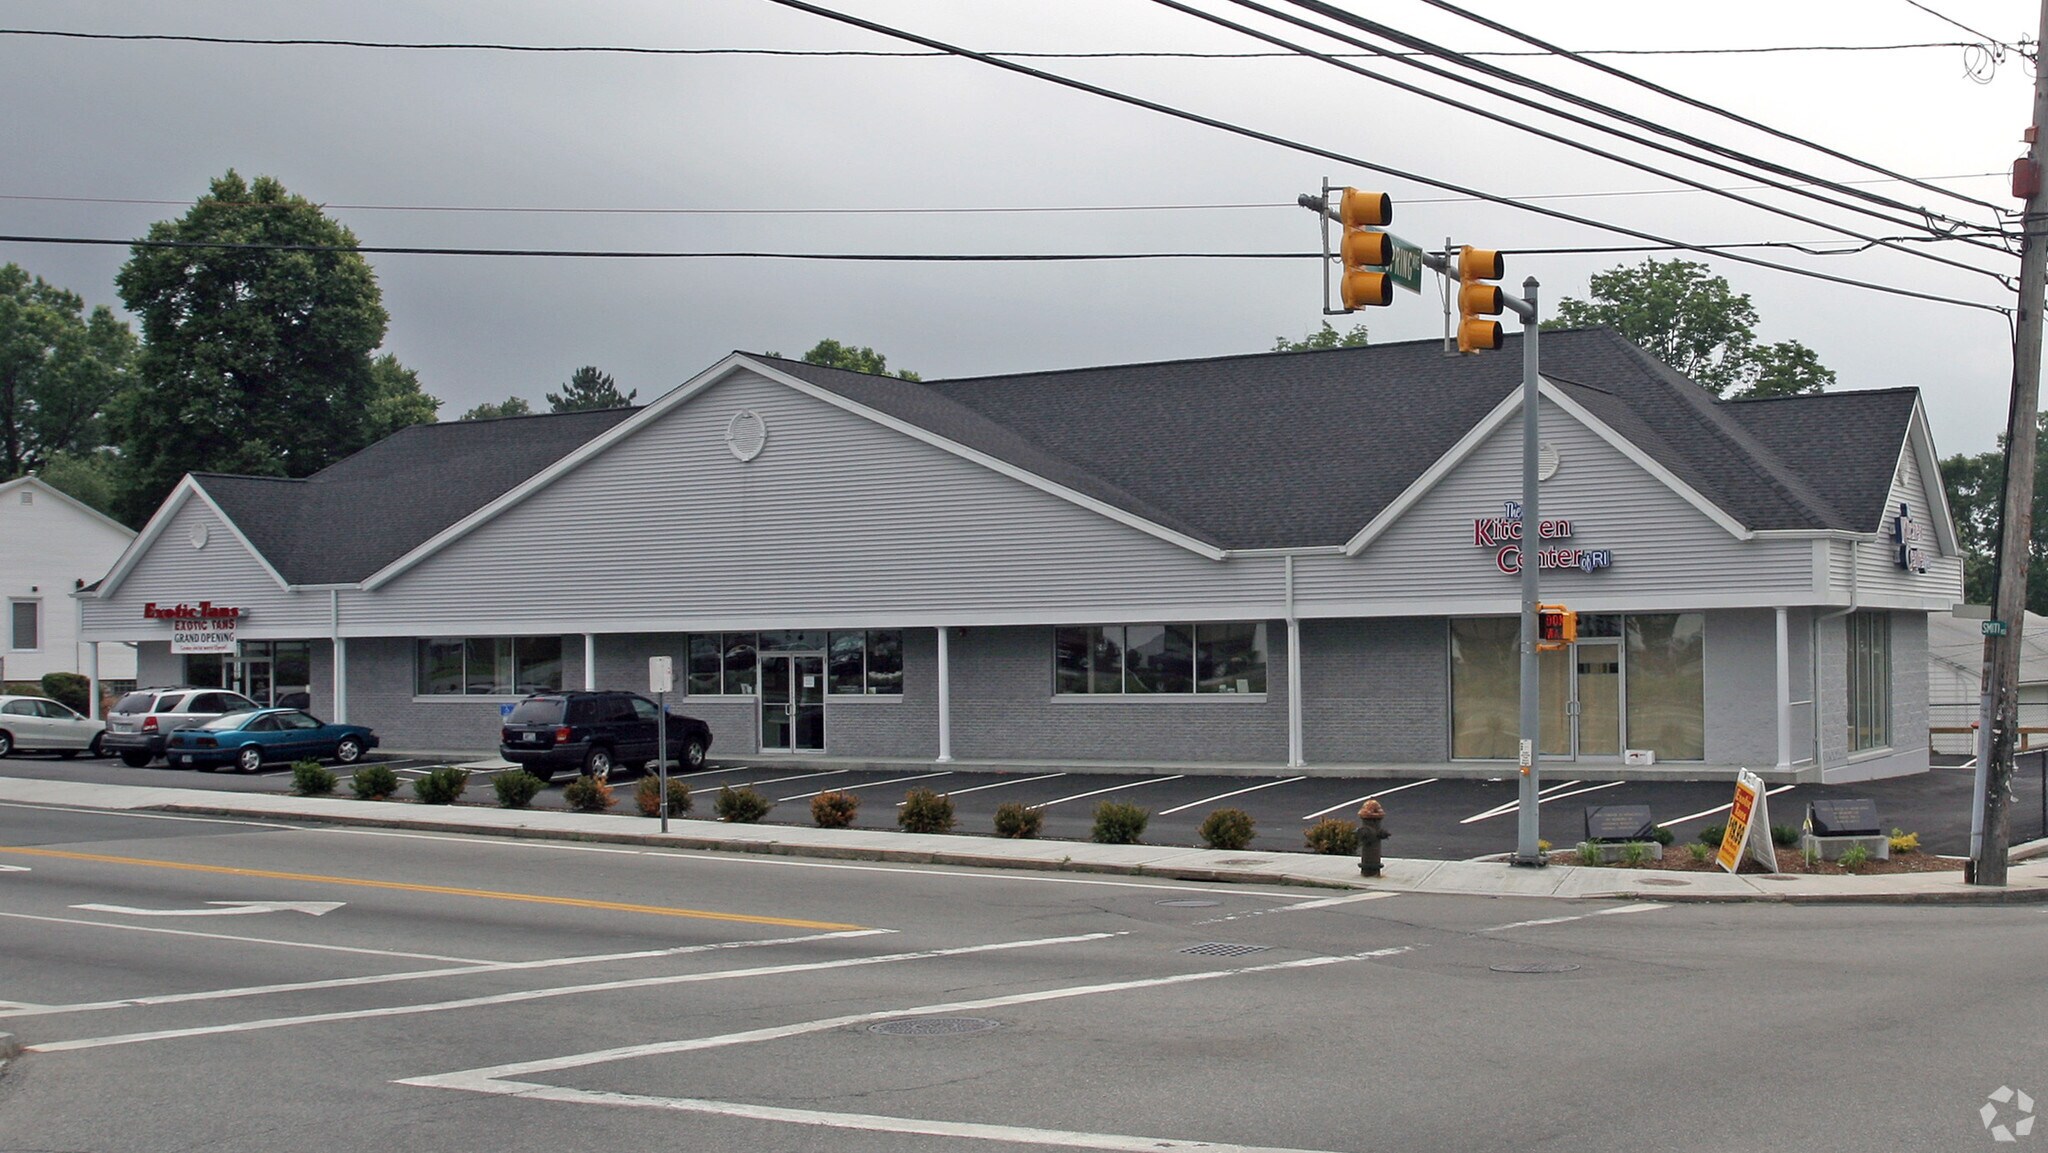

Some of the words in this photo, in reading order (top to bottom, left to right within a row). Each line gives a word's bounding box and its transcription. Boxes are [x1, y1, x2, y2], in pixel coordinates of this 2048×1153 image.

[1385, 244, 1413, 281] PRING
[1504, 501, 1523, 519] The
[1473, 518, 1572, 547] Kitcen
[1592, 551, 1608, 567] RI
[144, 603, 197, 618] Exotic
[198, 601, 240, 618] Tans
[174, 620, 208, 631] EXOTIC
[211, 619, 236, 630] TANS
[174, 633, 200, 643] GRAND
[201, 632, 235, 643] OPENING
